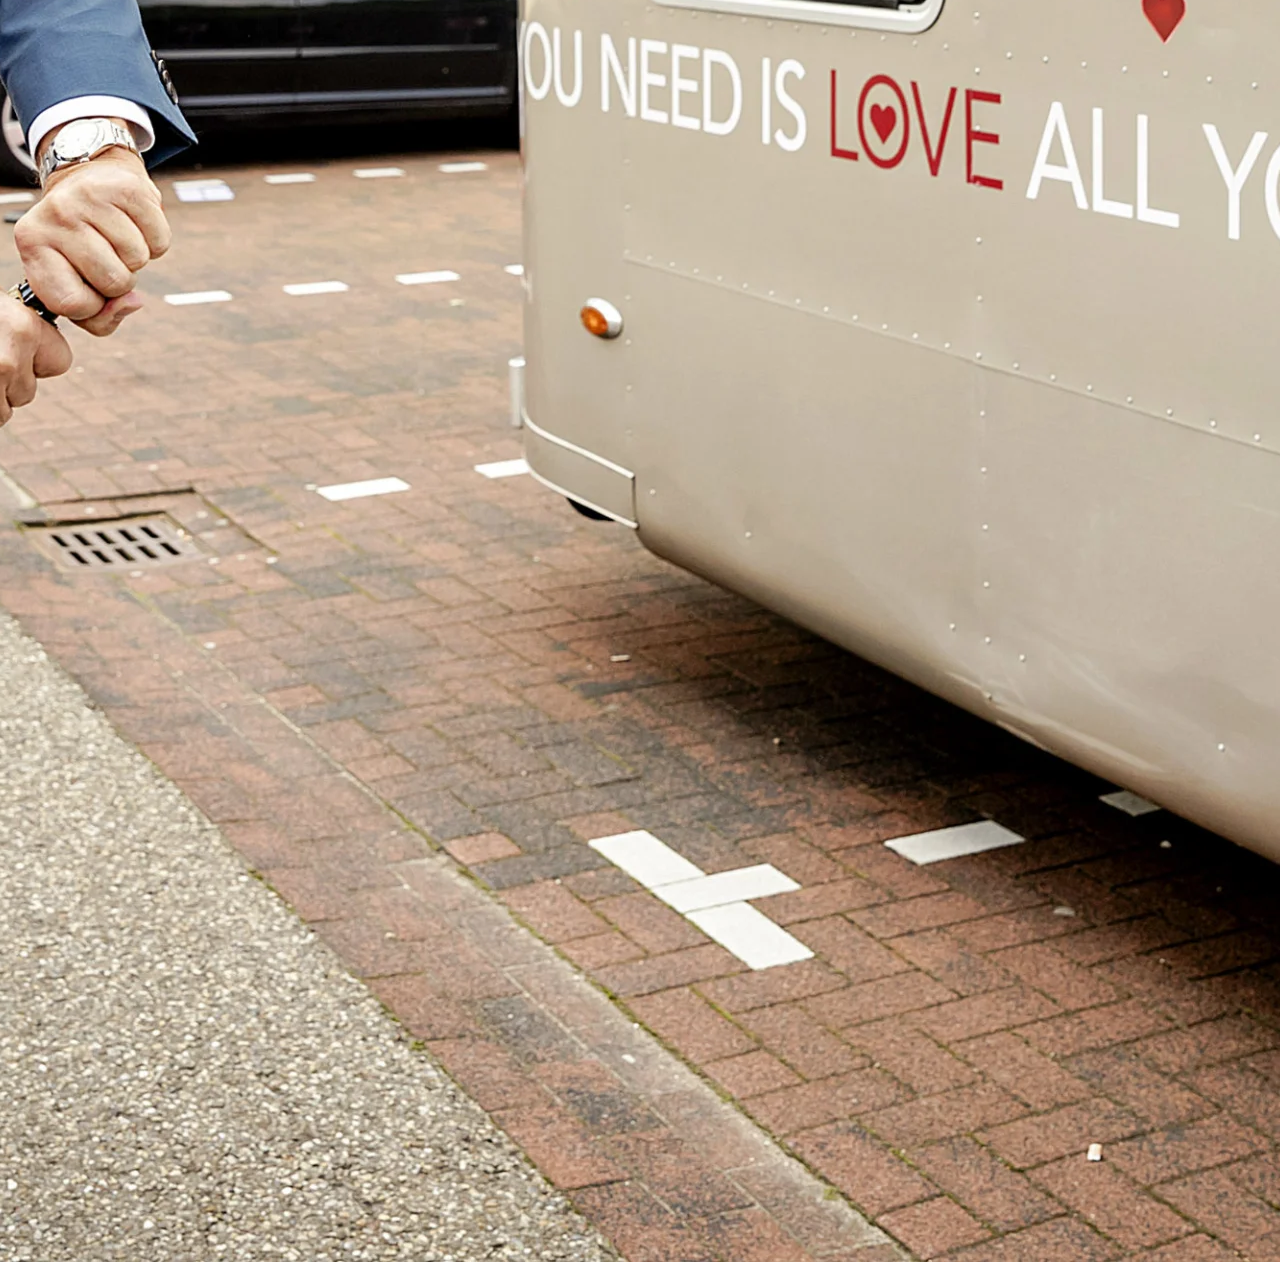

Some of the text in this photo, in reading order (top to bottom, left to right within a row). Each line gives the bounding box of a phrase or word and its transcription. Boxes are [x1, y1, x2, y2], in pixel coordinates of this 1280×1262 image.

[520, 21, 582, 107] OU
[600, 33, 742, 135] NEED
[761, 57, 807, 152] IS
[829, 69, 1004, 190] LOVE
[1026, 101, 1180, 228] ALL
